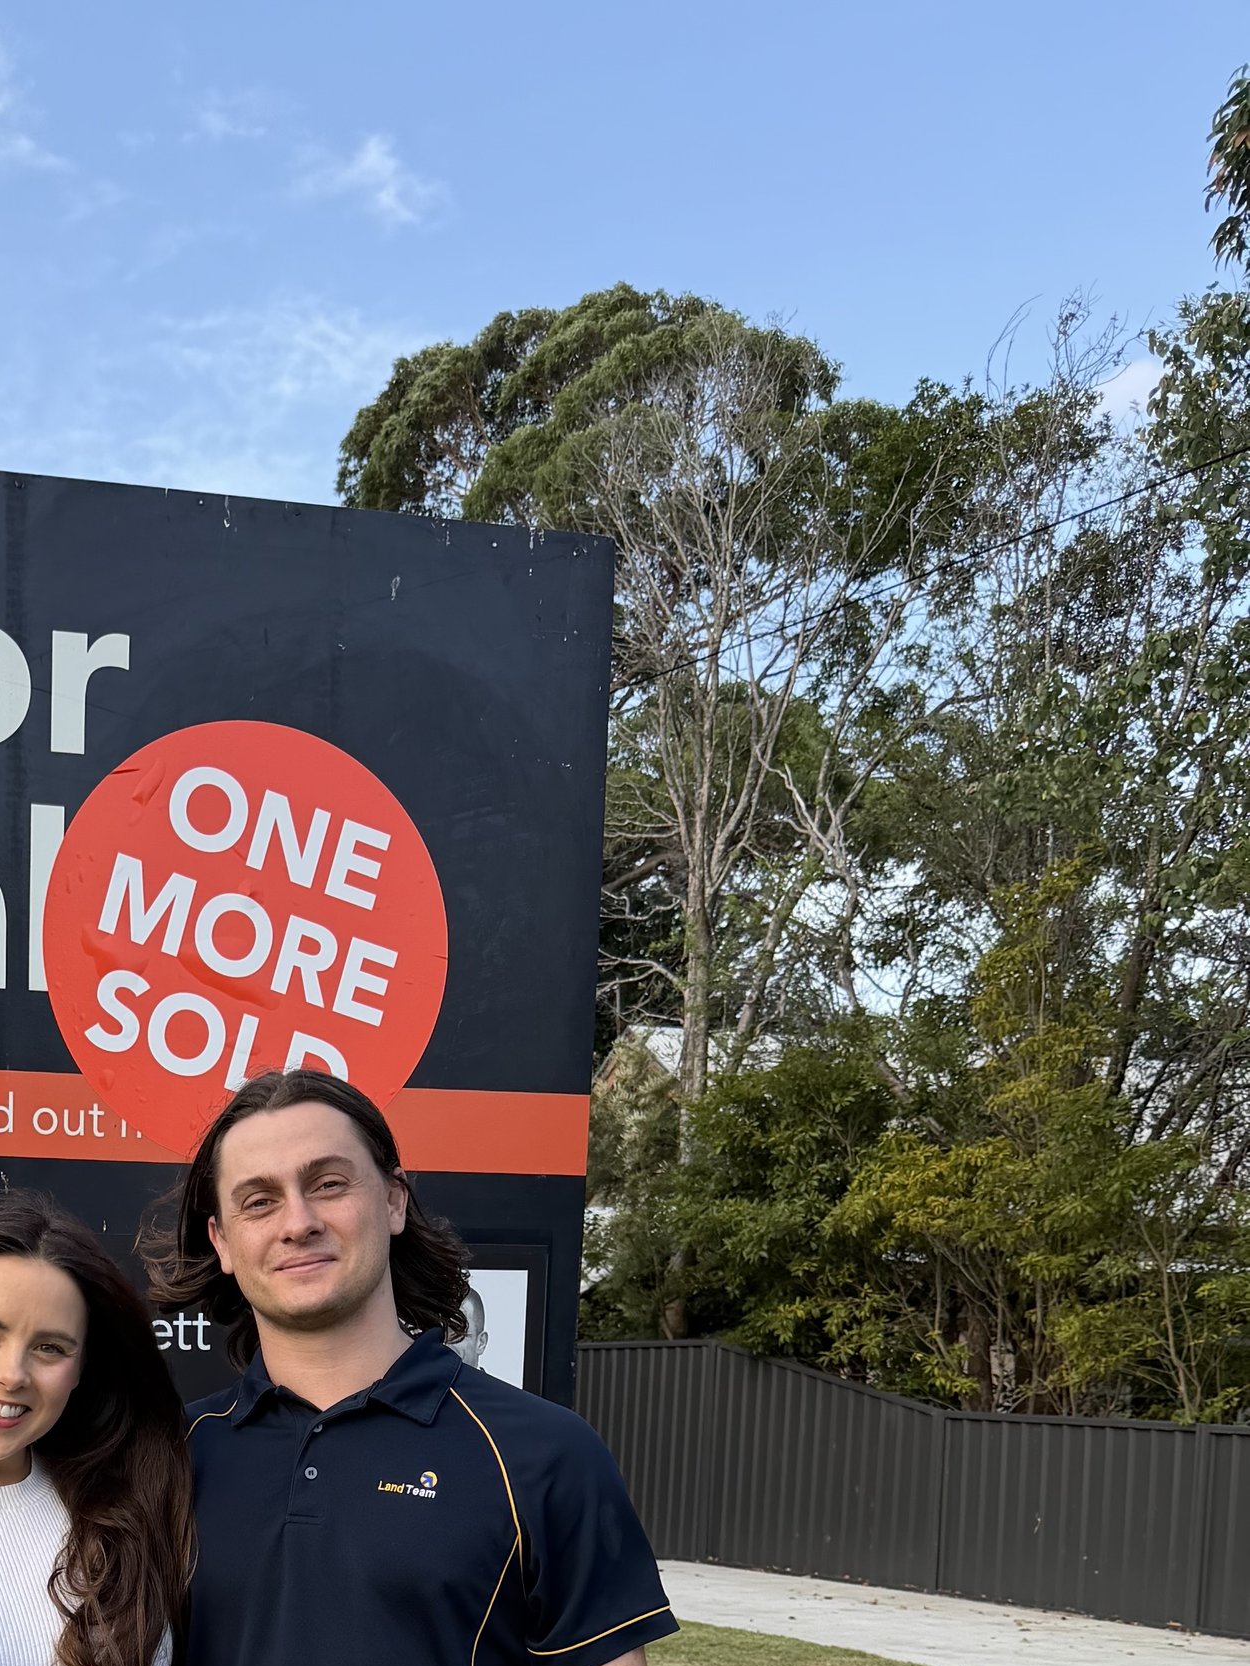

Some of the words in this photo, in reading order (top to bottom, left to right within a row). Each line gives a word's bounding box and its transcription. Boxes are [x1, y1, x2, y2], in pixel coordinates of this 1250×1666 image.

[168, 766, 392, 912] ONE
[97, 852, 399, 1028] MORE
[32, 1103, 105, 1138] out
[151, 1312, 212, 1351] ett
[377, 1480, 405, 1494] Land
[405, 1484, 437, 1499] Team
